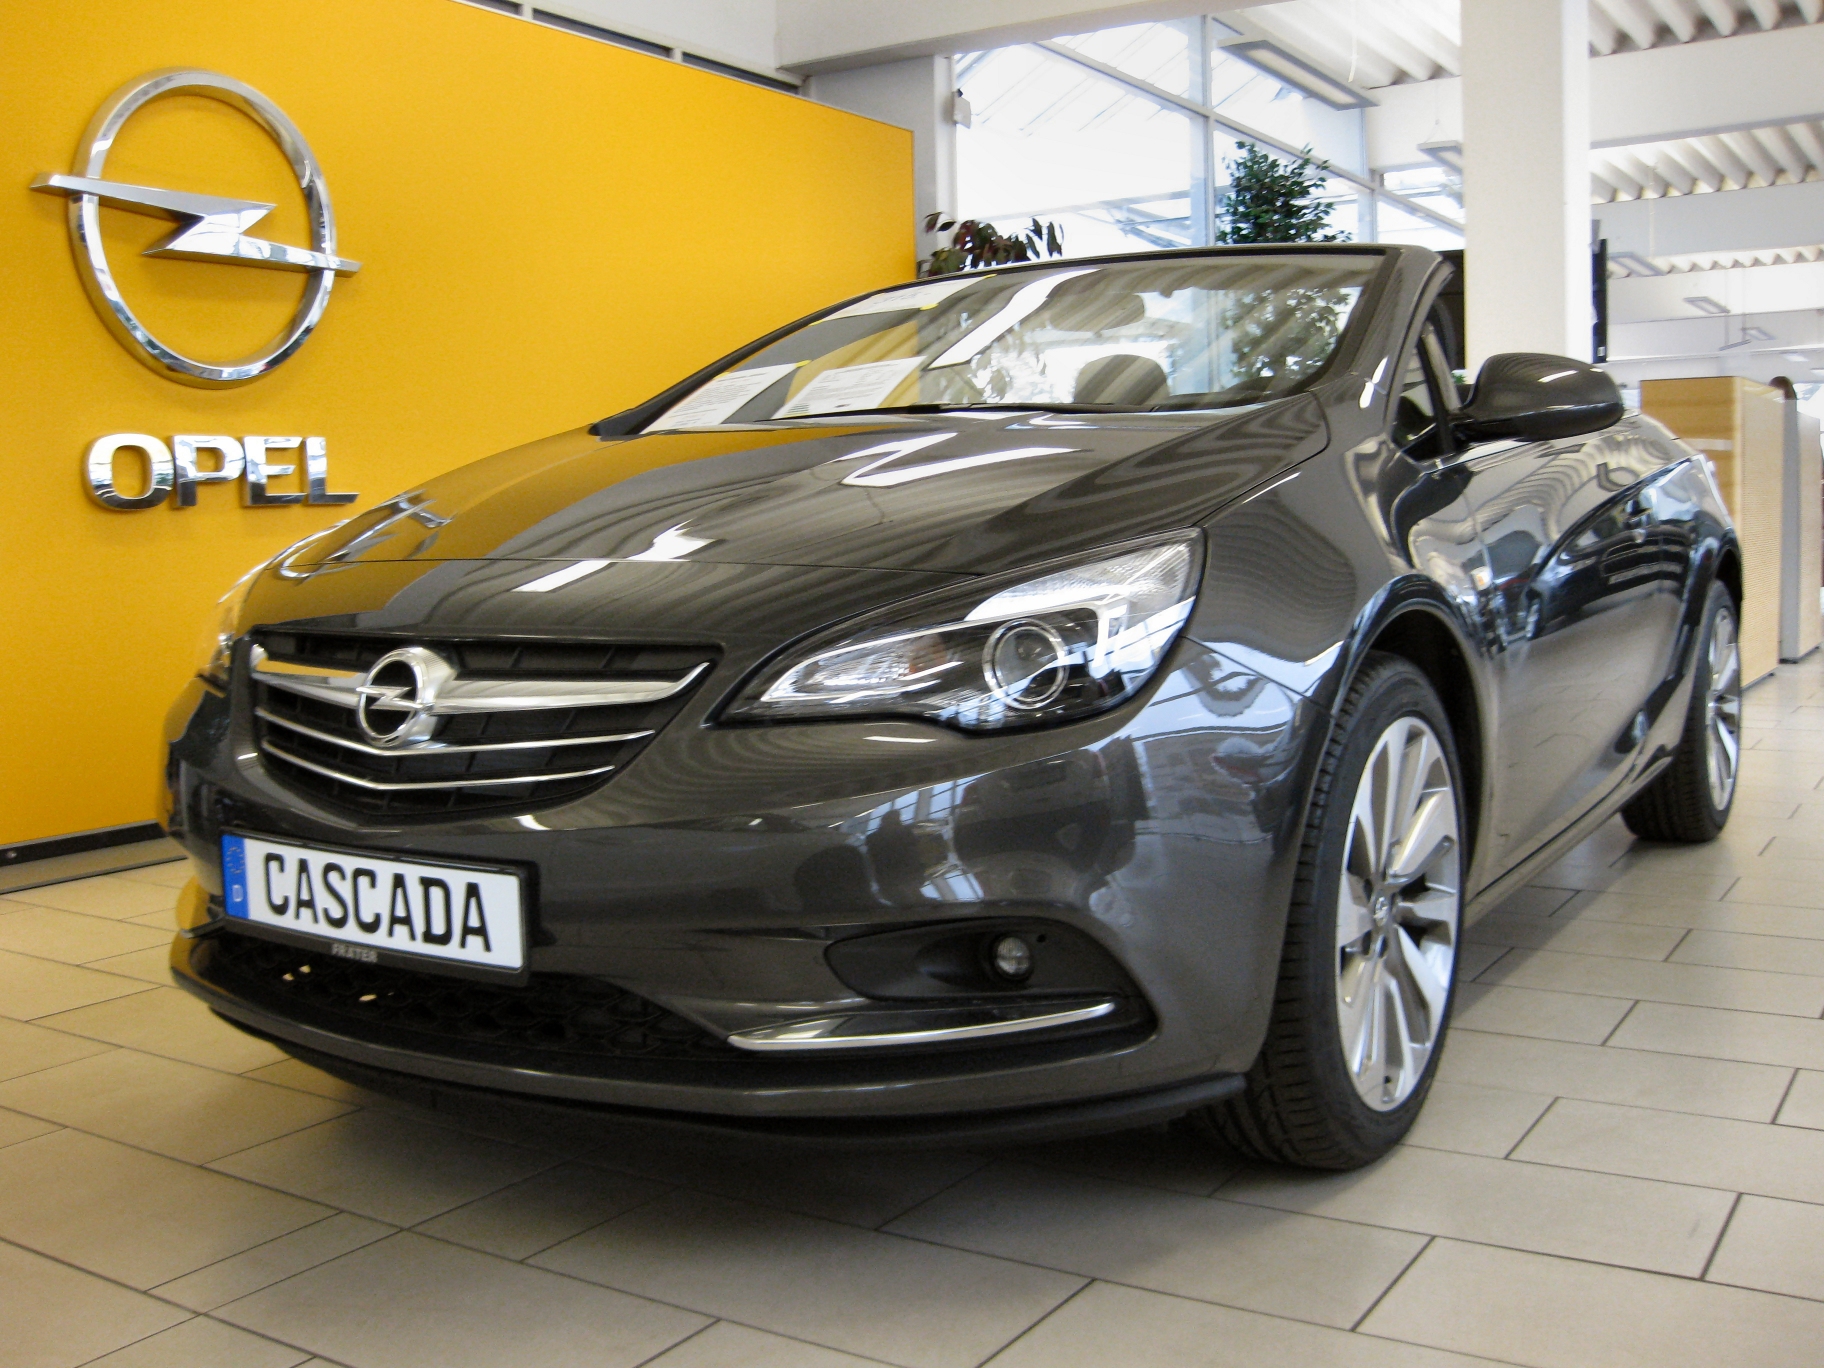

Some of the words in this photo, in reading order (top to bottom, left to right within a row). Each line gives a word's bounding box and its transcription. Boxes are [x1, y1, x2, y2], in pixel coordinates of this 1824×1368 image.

[84, 433, 359, 511] OPEL
[232, 884, 244, 903] D
[264, 852, 492, 952] CASCADA
